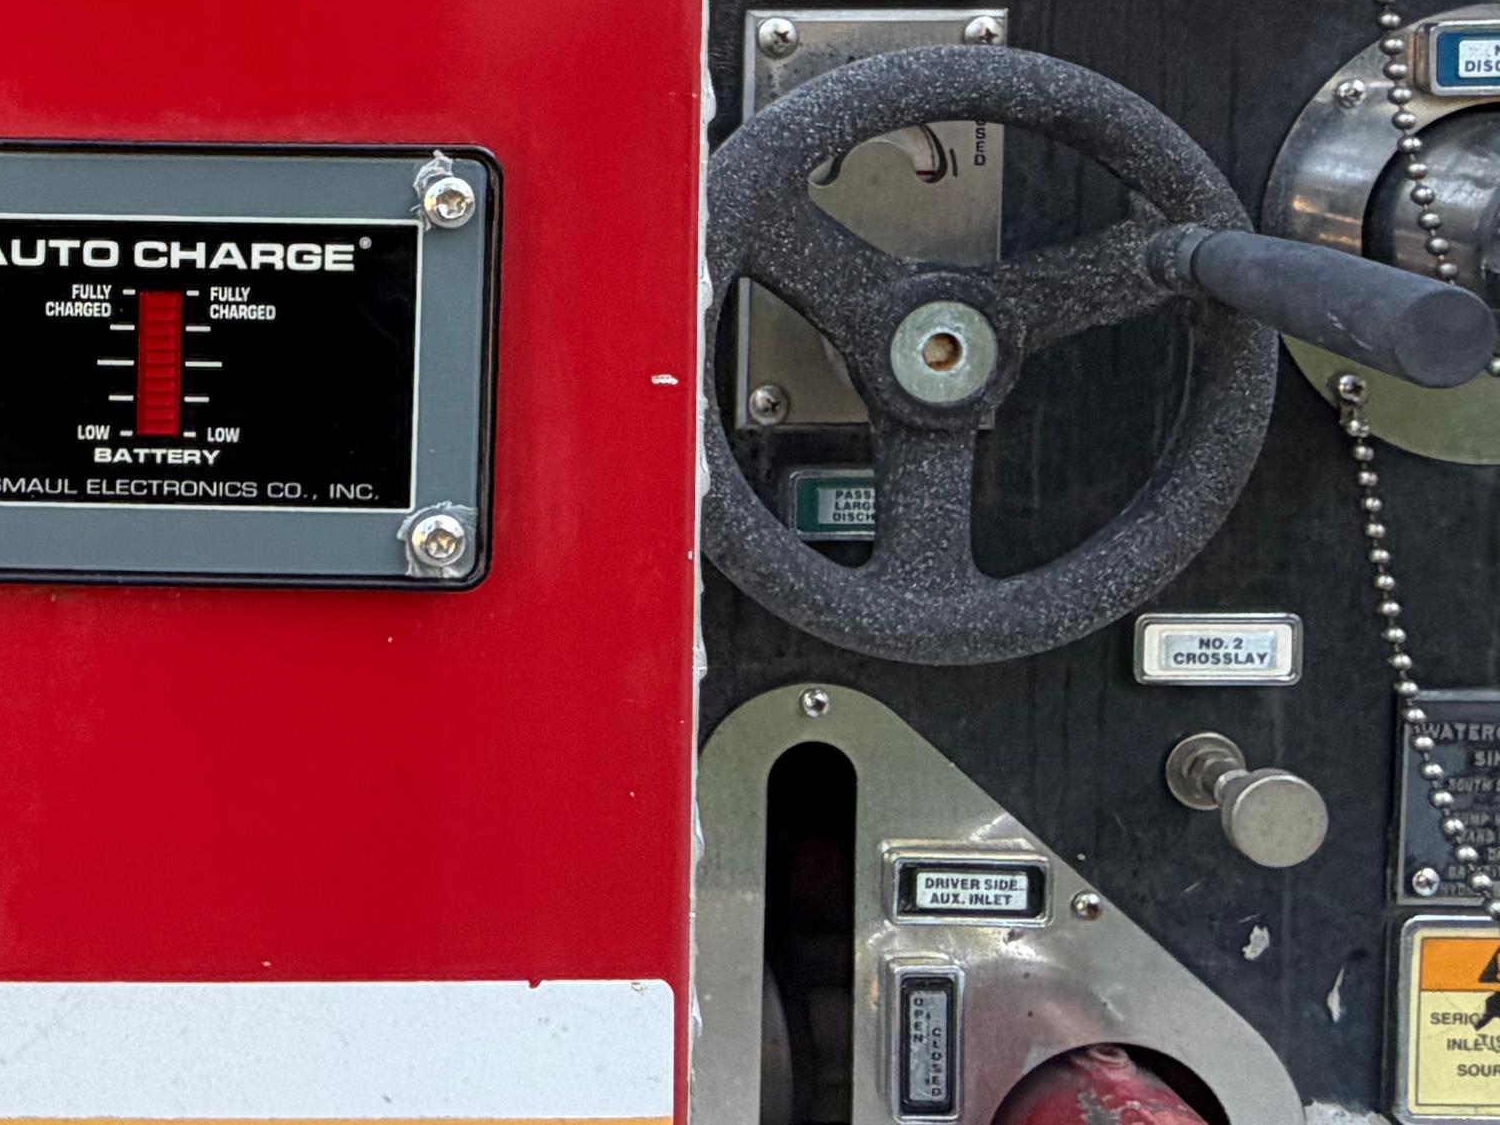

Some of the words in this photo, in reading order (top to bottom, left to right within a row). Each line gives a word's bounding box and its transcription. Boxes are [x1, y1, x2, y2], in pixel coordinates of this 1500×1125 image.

[134, 241, 355, 271] CHARGE
[72, 284, 111, 300] FULLY
[210, 287, 250, 302] FULLY
[45, 302, 111, 317] CHARGED
[210, 305, 276, 320] CHARGED
[78, 425, 110, 440] LOW
[207, 428, 239, 442] LOW
[94, 448, 220, 464] BATTERY
[86, 479, 257, 498] ELECTRONICS
[267, 482, 316, 500] CO.,
[330, 483, 379, 500] INC.
[835, 501, 875, 510] LARG
[1198, 637, 1228, 650] NO.
[1233, 637, 1244, 649] 2
[1173, 652, 1268, 665] CROSSLAY
[925, 877, 981, 890] DRIVER
[984, 878, 1018, 891] SIDE
[930, 893, 965, 905] AUX.
[969, 894, 1012, 906] INLET
[914, 998, 923, 1043] OPEN
[932, 1027, 942, 1097] CLOSED
